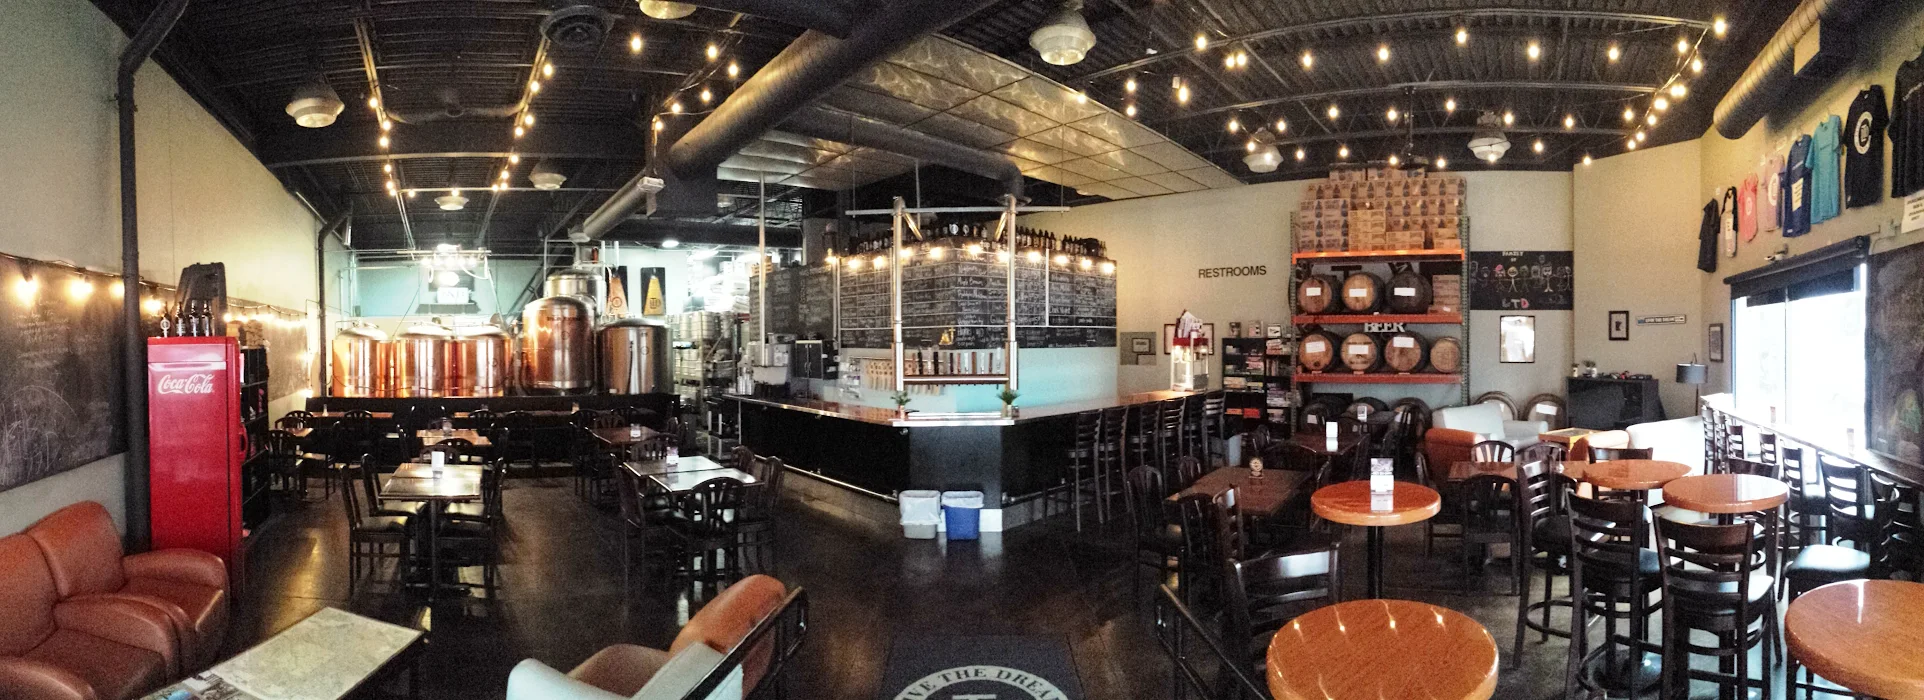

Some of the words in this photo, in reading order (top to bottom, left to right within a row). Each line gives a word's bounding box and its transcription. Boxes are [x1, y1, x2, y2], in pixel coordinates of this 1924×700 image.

[1198, 265, 1267, 278] RESTROOMS
[1502, 298, 1530, 309] LTD
[1364, 322, 1406, 333] BEER
[158, 373, 215, 394] Coca-Cola
[938, 668, 987, 683] THE
